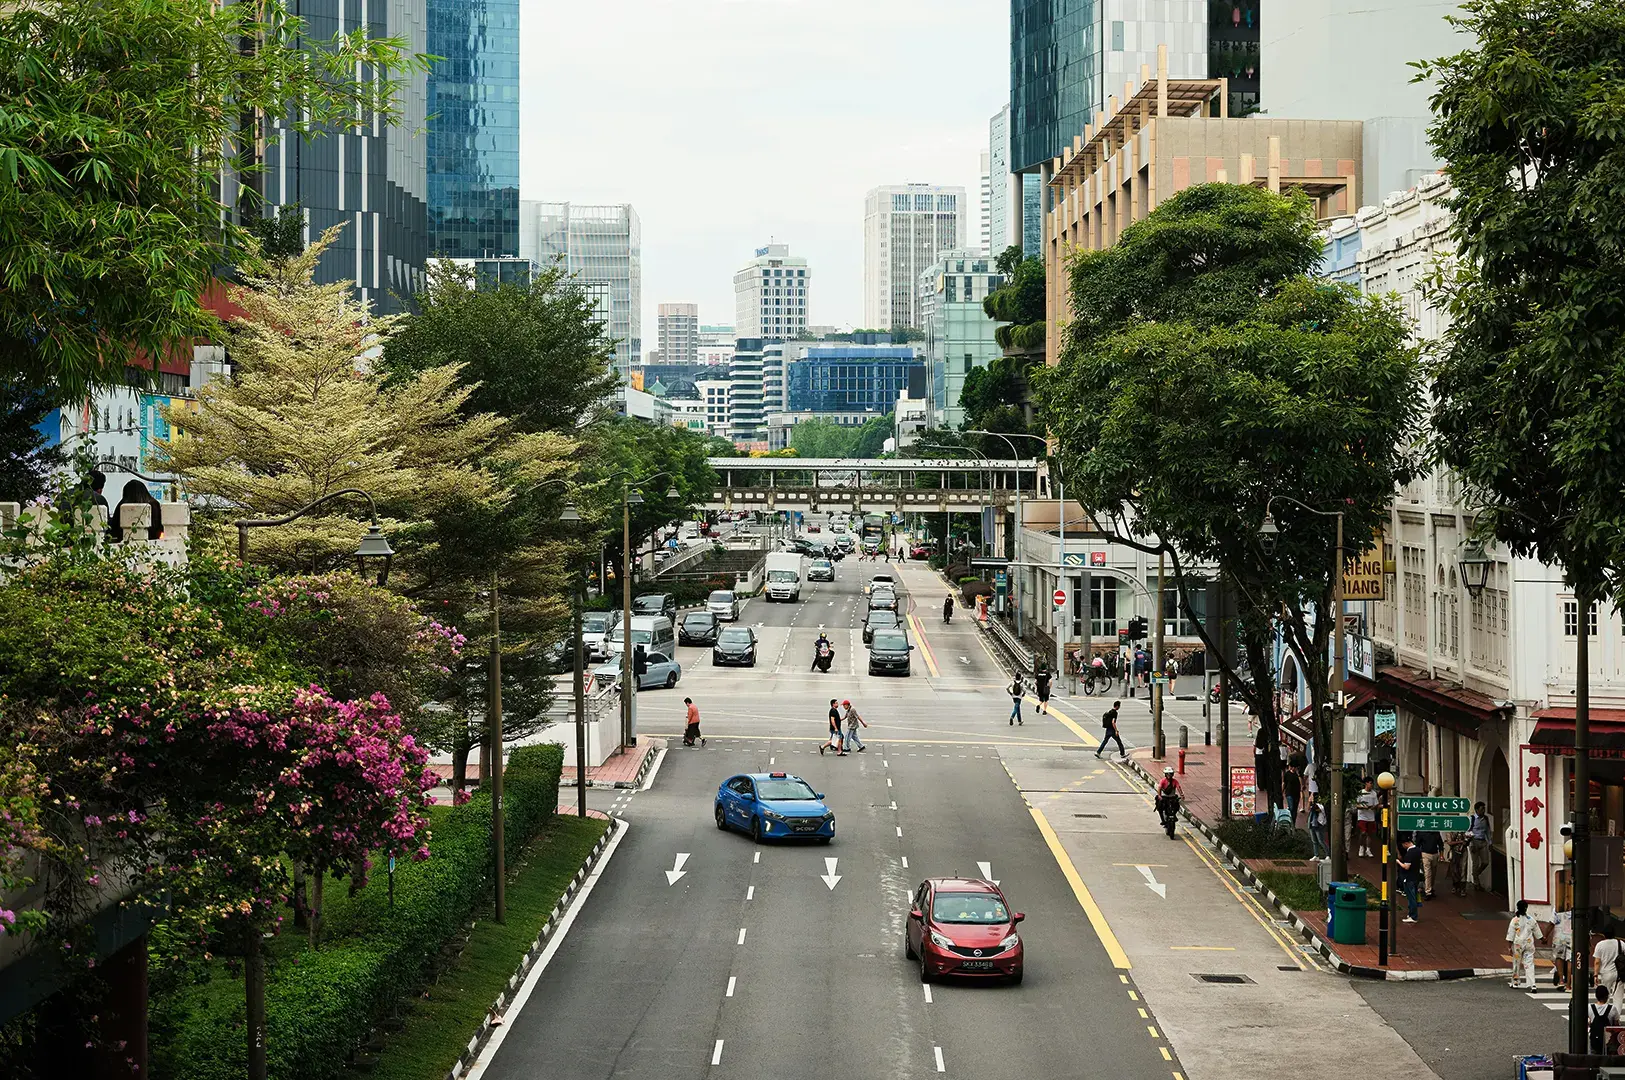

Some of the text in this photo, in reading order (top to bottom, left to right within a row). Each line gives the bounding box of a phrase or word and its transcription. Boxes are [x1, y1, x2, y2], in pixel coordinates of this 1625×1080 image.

[1346, 561, 1381, 576] HENG
[1401, 799, 1465, 811] Mosque St
[1415, 819, 1453, 829] 摩士街
[1576, 951, 1582, 970] 23
